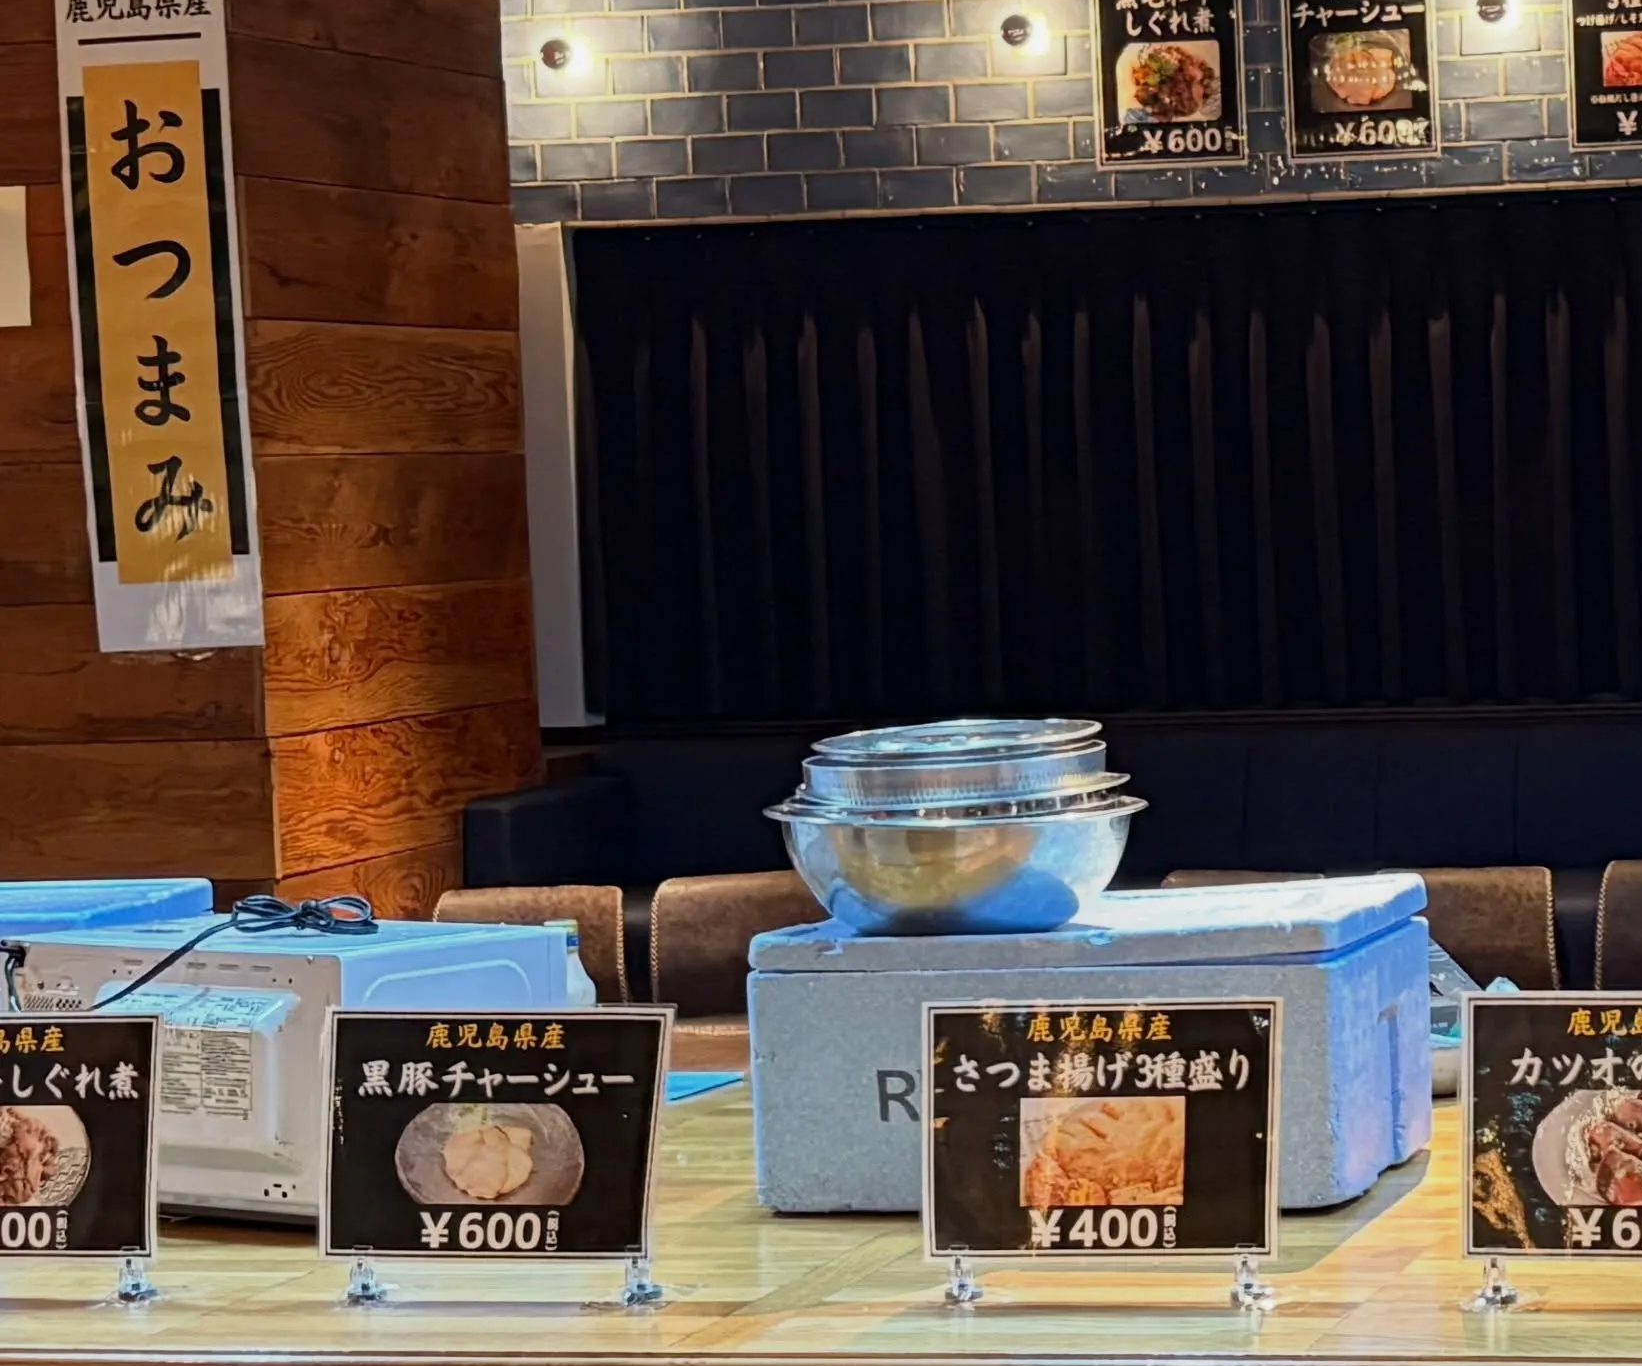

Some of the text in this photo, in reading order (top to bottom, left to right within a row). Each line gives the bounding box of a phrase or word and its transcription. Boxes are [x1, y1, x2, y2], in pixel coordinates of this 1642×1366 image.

[1126, 9, 1216, 37] しぐれ煮
[1292, 0, 1425, 29] チャーシュー
[1142, 127, 1223, 154] ¥600
[111, 99, 213, 541] おつまみ
[426, 1022, 566, 1050] 鹿児島県産
[1026, 1013, 1172, 1043] 鹿児島県産
[0, 1061, 139, 1100] しぐれ煮
[358, 1059, 635, 1098] 黒豚チャーシュー
[953, 1047, 1251, 1092] さつま揚げ3種盛り
[876, 1069, 921, 1123] R
[419, 1211, 541, 1250] ¥600
[1029, 1208, 1158, 1248] ¥400
